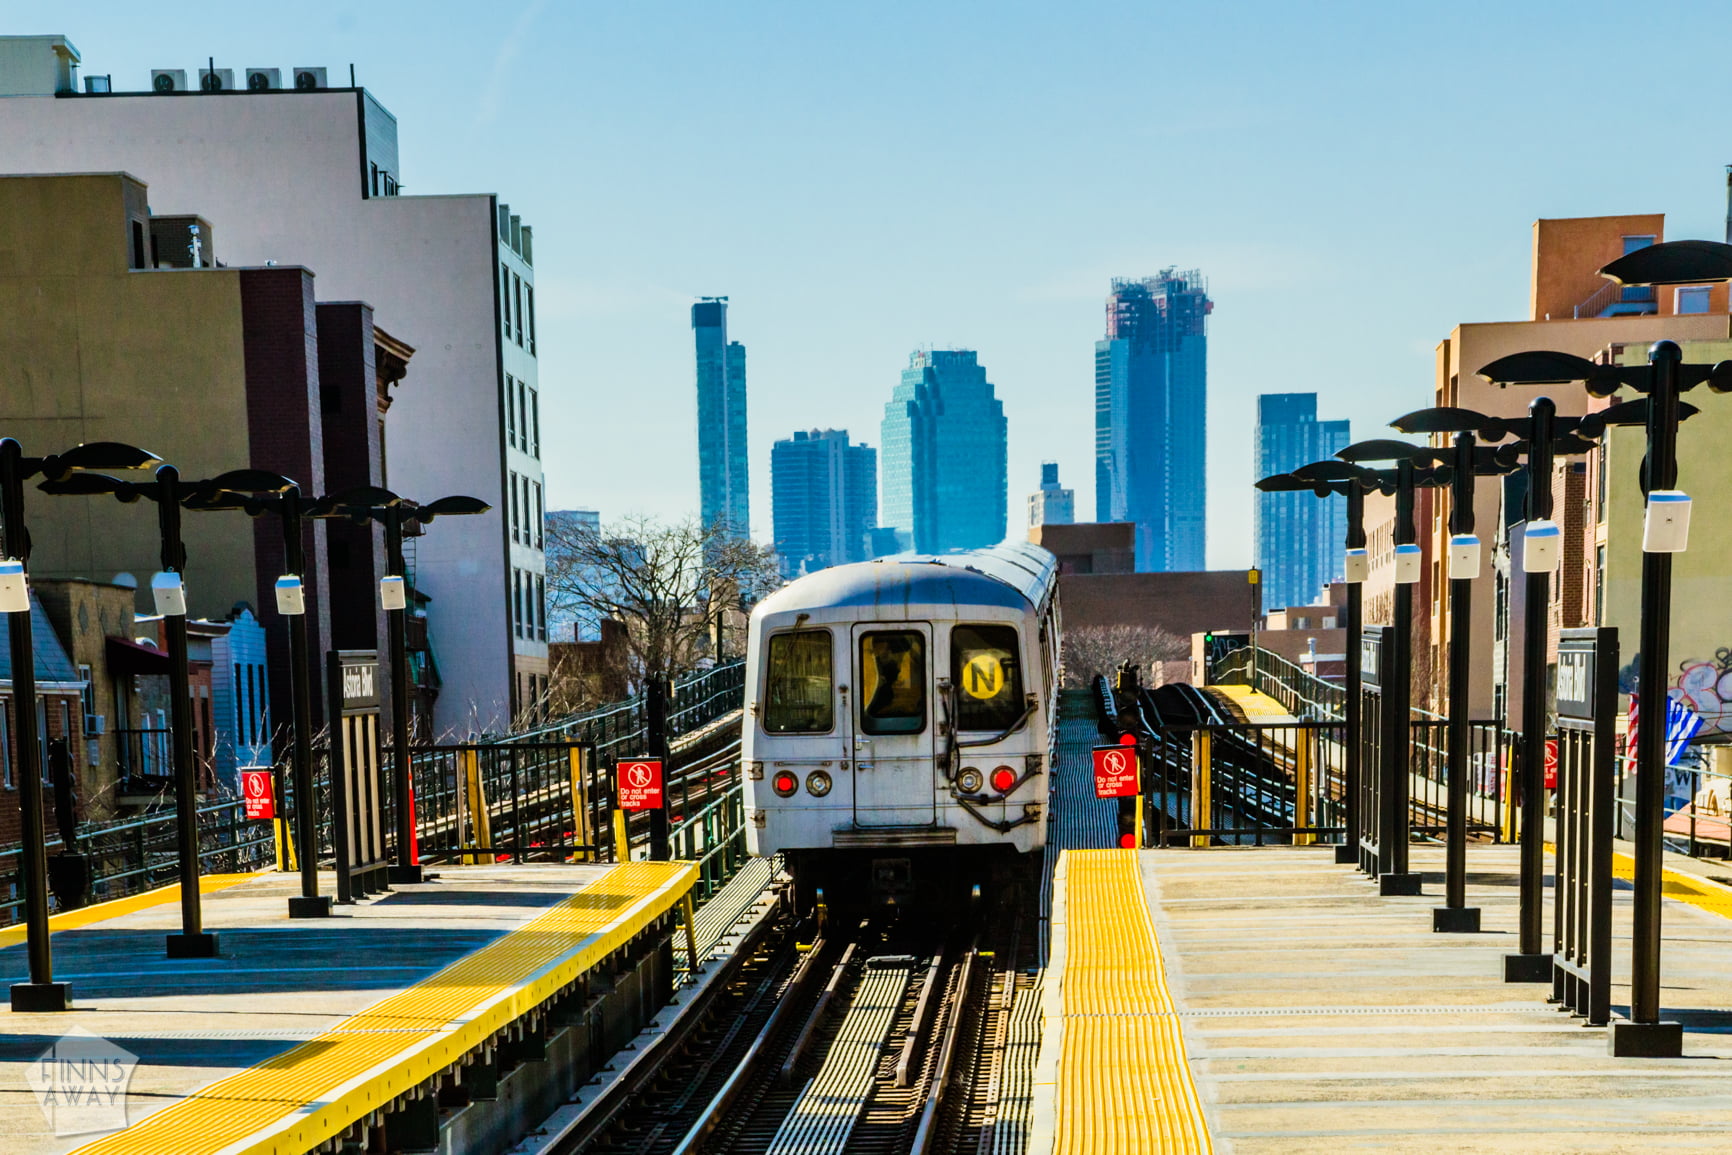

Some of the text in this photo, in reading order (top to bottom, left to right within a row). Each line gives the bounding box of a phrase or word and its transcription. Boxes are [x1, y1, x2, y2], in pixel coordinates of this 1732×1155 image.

[343, 666, 373, 698] Astoria Blvd
[971, 662, 995, 692] N
[1556, 653, 1586, 703] Astoria Blvd
[1098, 788, 1117, 796] tracks
